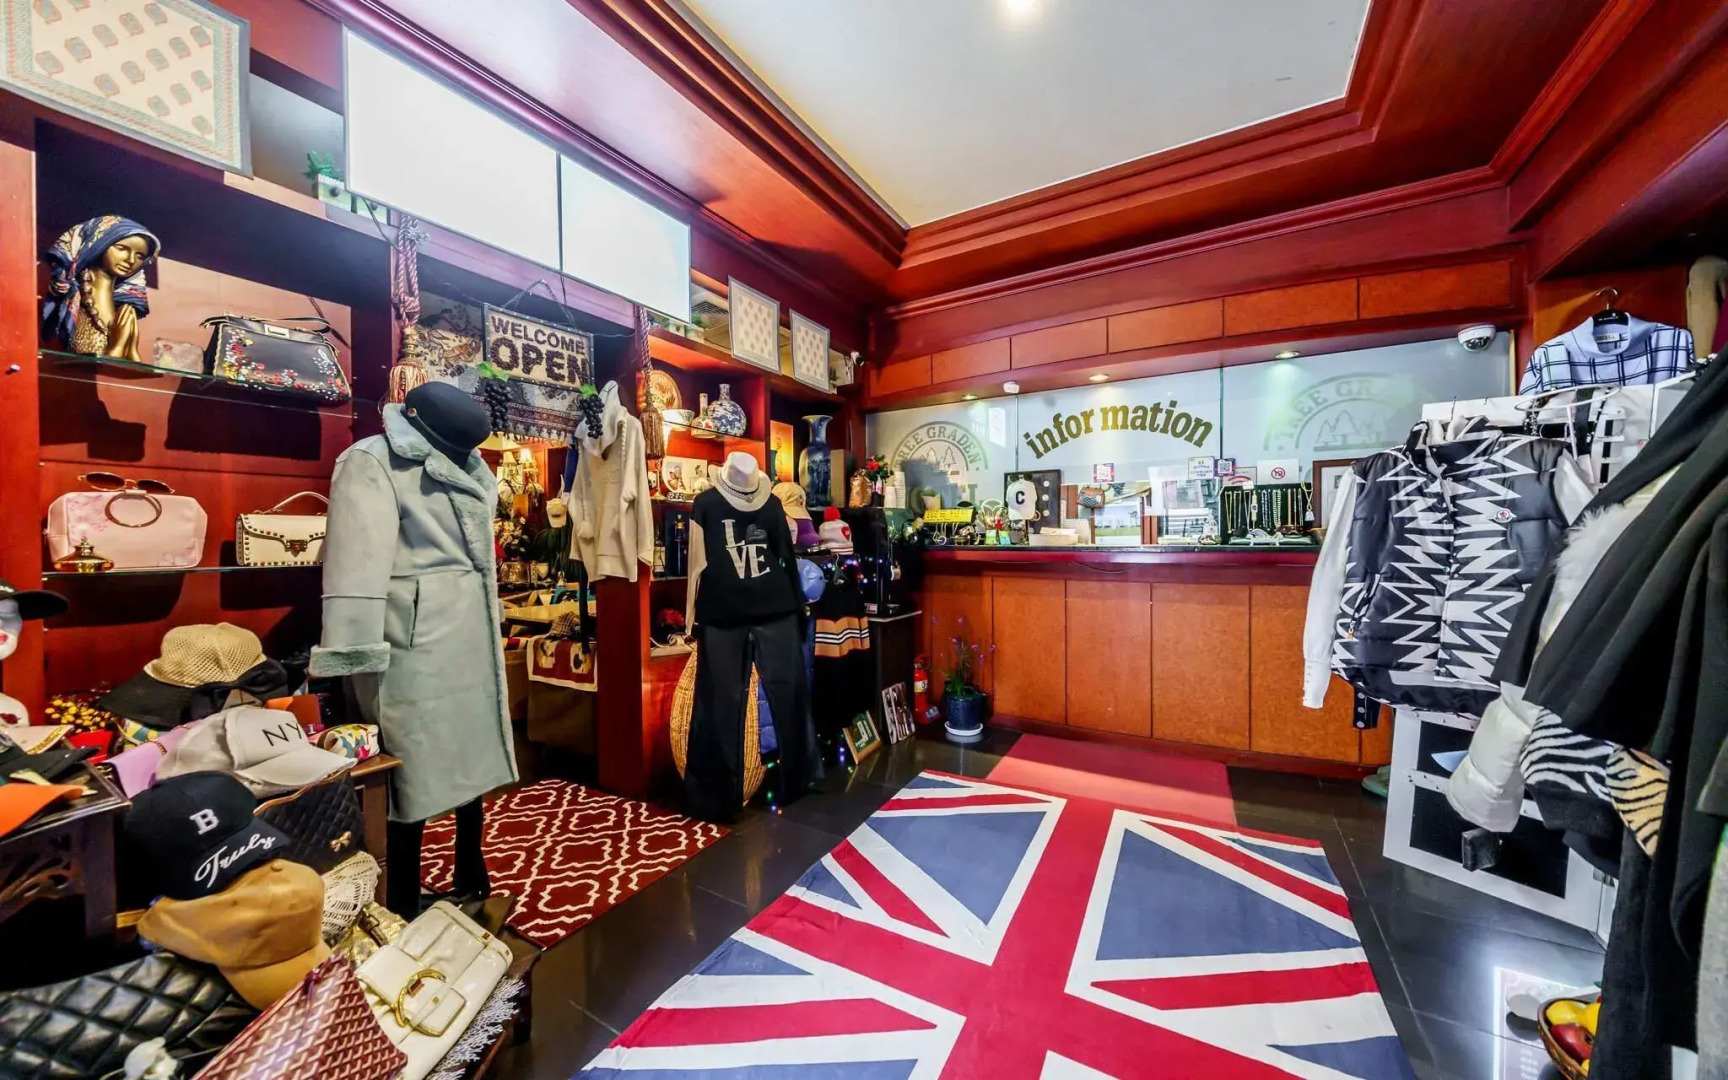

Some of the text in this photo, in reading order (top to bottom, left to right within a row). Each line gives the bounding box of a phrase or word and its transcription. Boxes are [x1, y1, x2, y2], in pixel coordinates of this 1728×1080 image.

[491, 315, 586, 355] WELCOME
[490, 337, 590, 386] OPEN
[1015, 490, 1025, 505] C
[262, 722, 303, 747] NY
[188, 807, 219, 836] B
[193, 832, 277, 889] Truly
